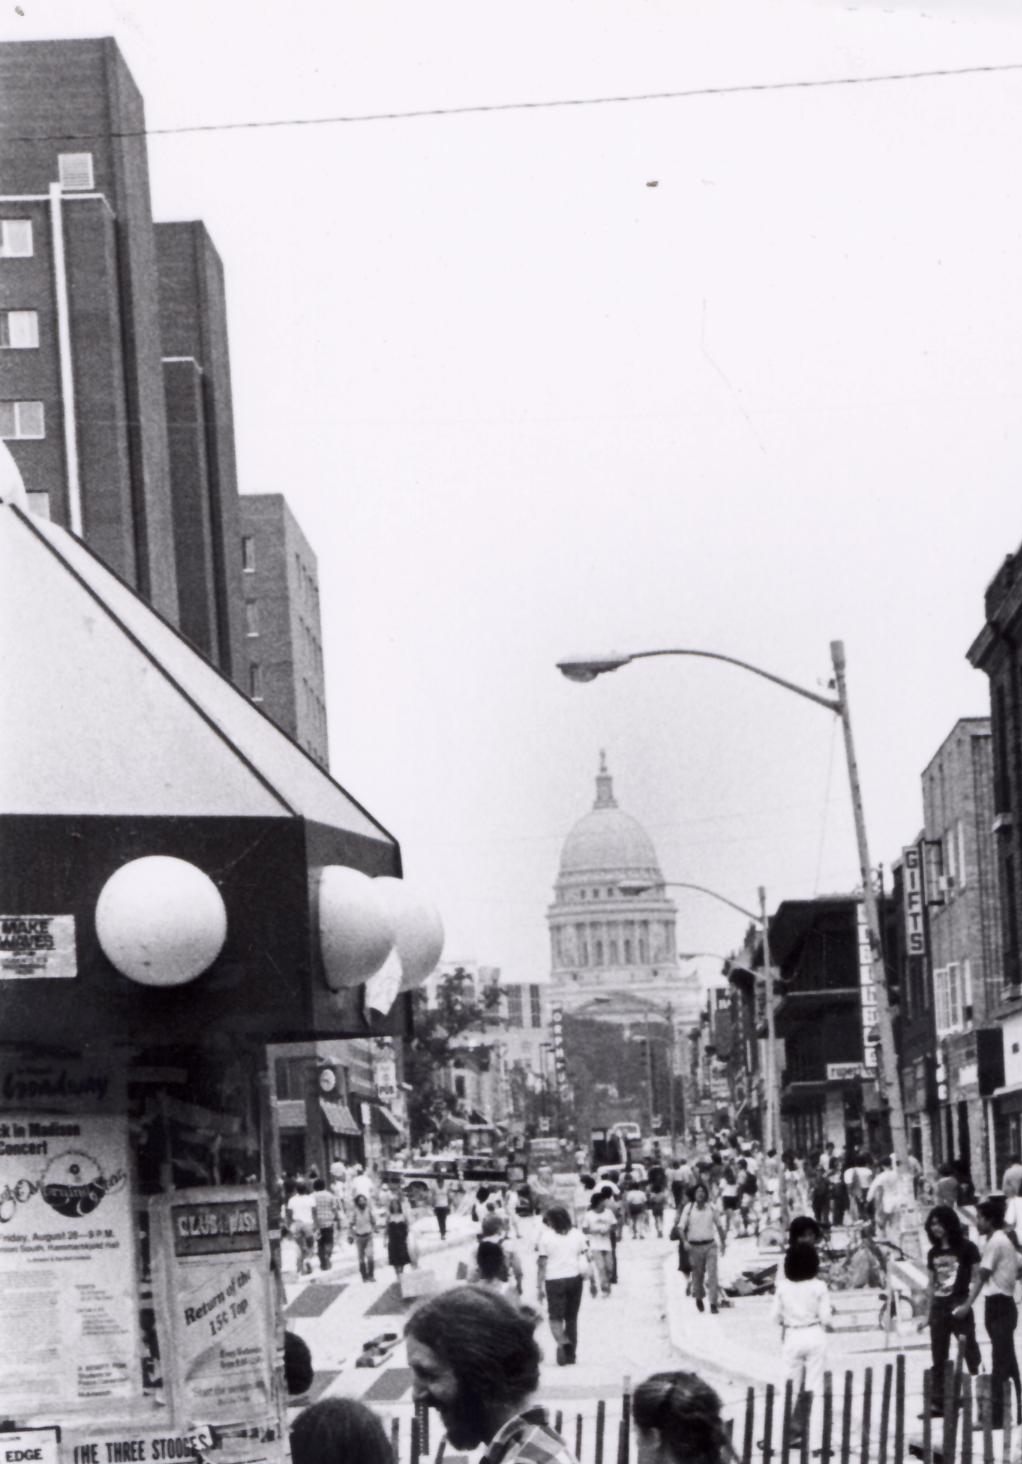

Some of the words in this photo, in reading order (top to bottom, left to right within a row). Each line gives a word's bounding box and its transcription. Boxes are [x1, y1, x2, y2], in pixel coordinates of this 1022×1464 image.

[905, 850, 924, 952] GIFTS
[178, 1213, 218, 1237] CLUB
[183, 1290, 226, 1326] Return
[225, 1276, 237, 1298] of
[5, 1448, 43, 1463] EDGE
[105, 1440, 146, 1464] THREE
